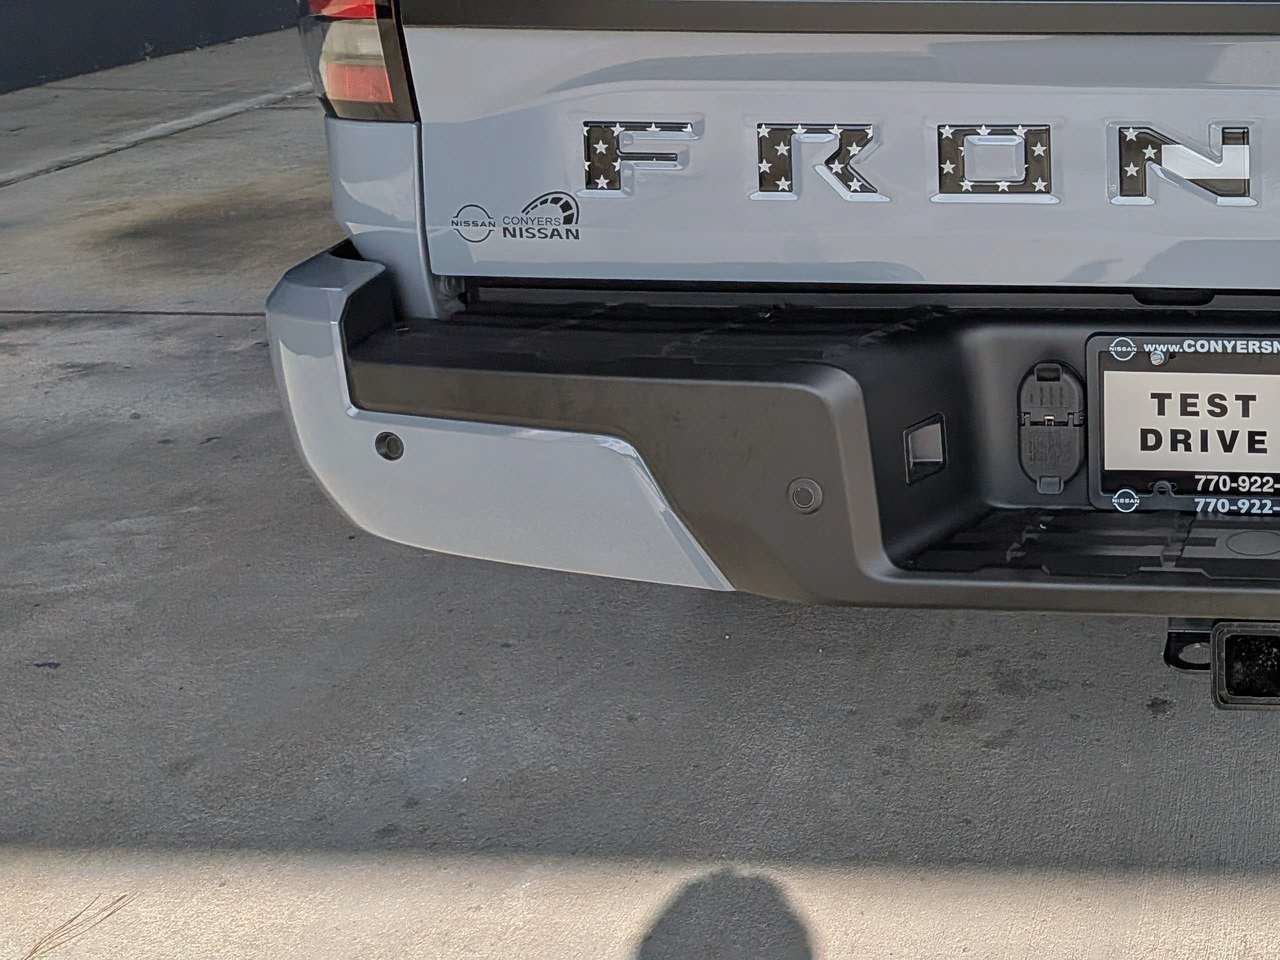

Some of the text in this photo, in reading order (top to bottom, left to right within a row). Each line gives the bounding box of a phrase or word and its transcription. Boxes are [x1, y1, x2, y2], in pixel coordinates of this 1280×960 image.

[451, 220, 496, 228] NISSAN
[502, 216, 561, 226] CONYERS
[502, 227, 579, 240] NISSAN
[1150, 392, 1257, 418] TEST
[1139, 427, 1268, 454] DRIVE
